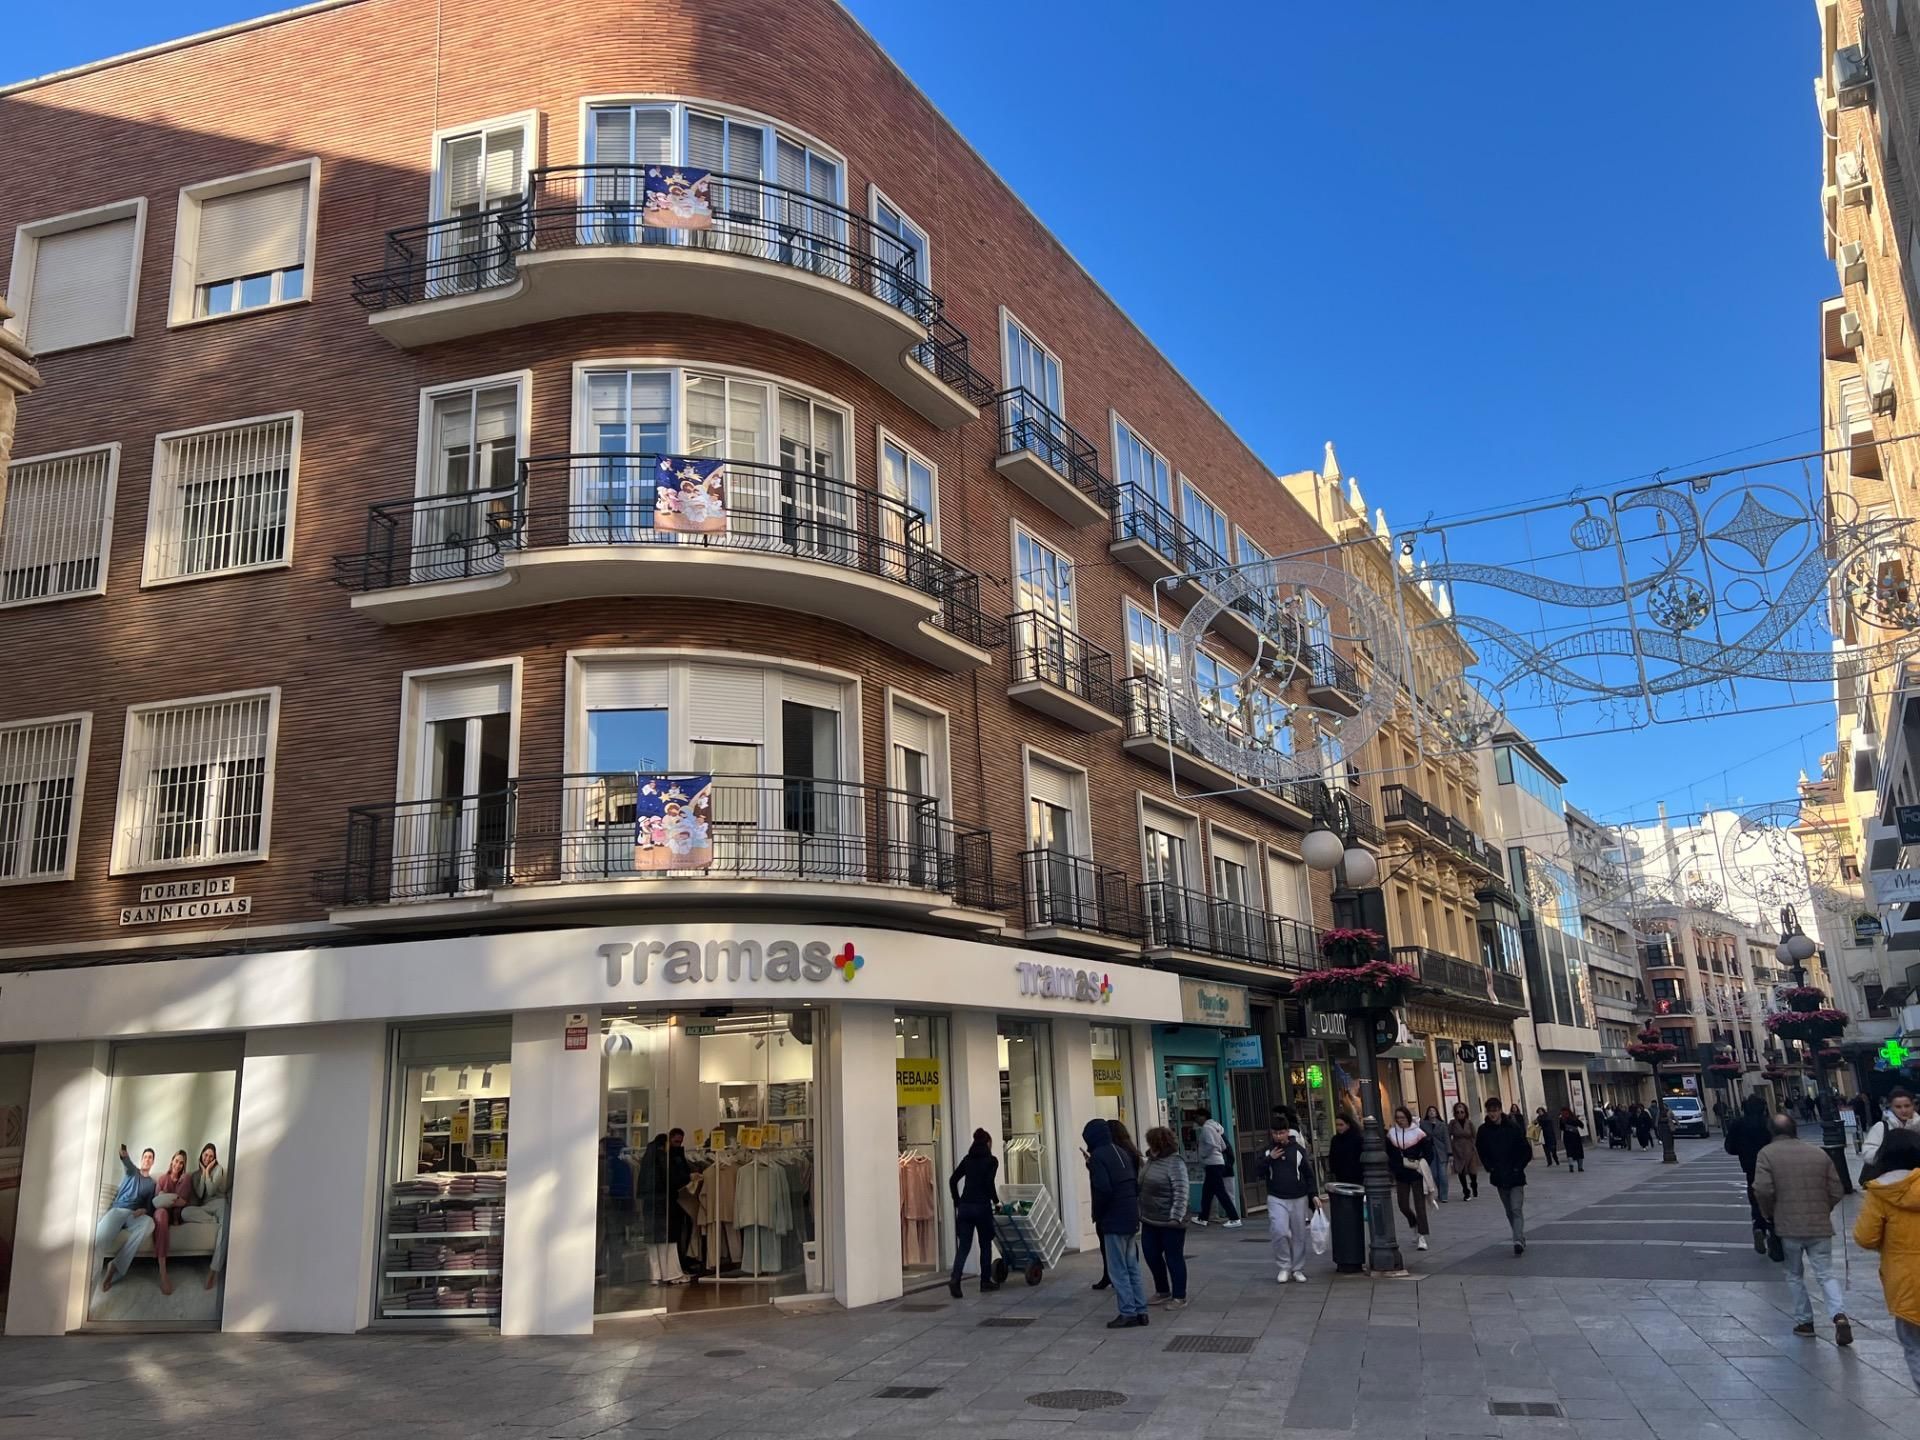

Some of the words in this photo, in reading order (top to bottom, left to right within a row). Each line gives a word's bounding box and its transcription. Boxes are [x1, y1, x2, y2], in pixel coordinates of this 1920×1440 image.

[142, 882, 201, 900] TORRE
[209, 880, 230, 893] DE
[122, 908, 156, 923] SAN
[162, 899, 247, 919] NICOLAS
[896, 1071, 939, 1085] REBAJAS
